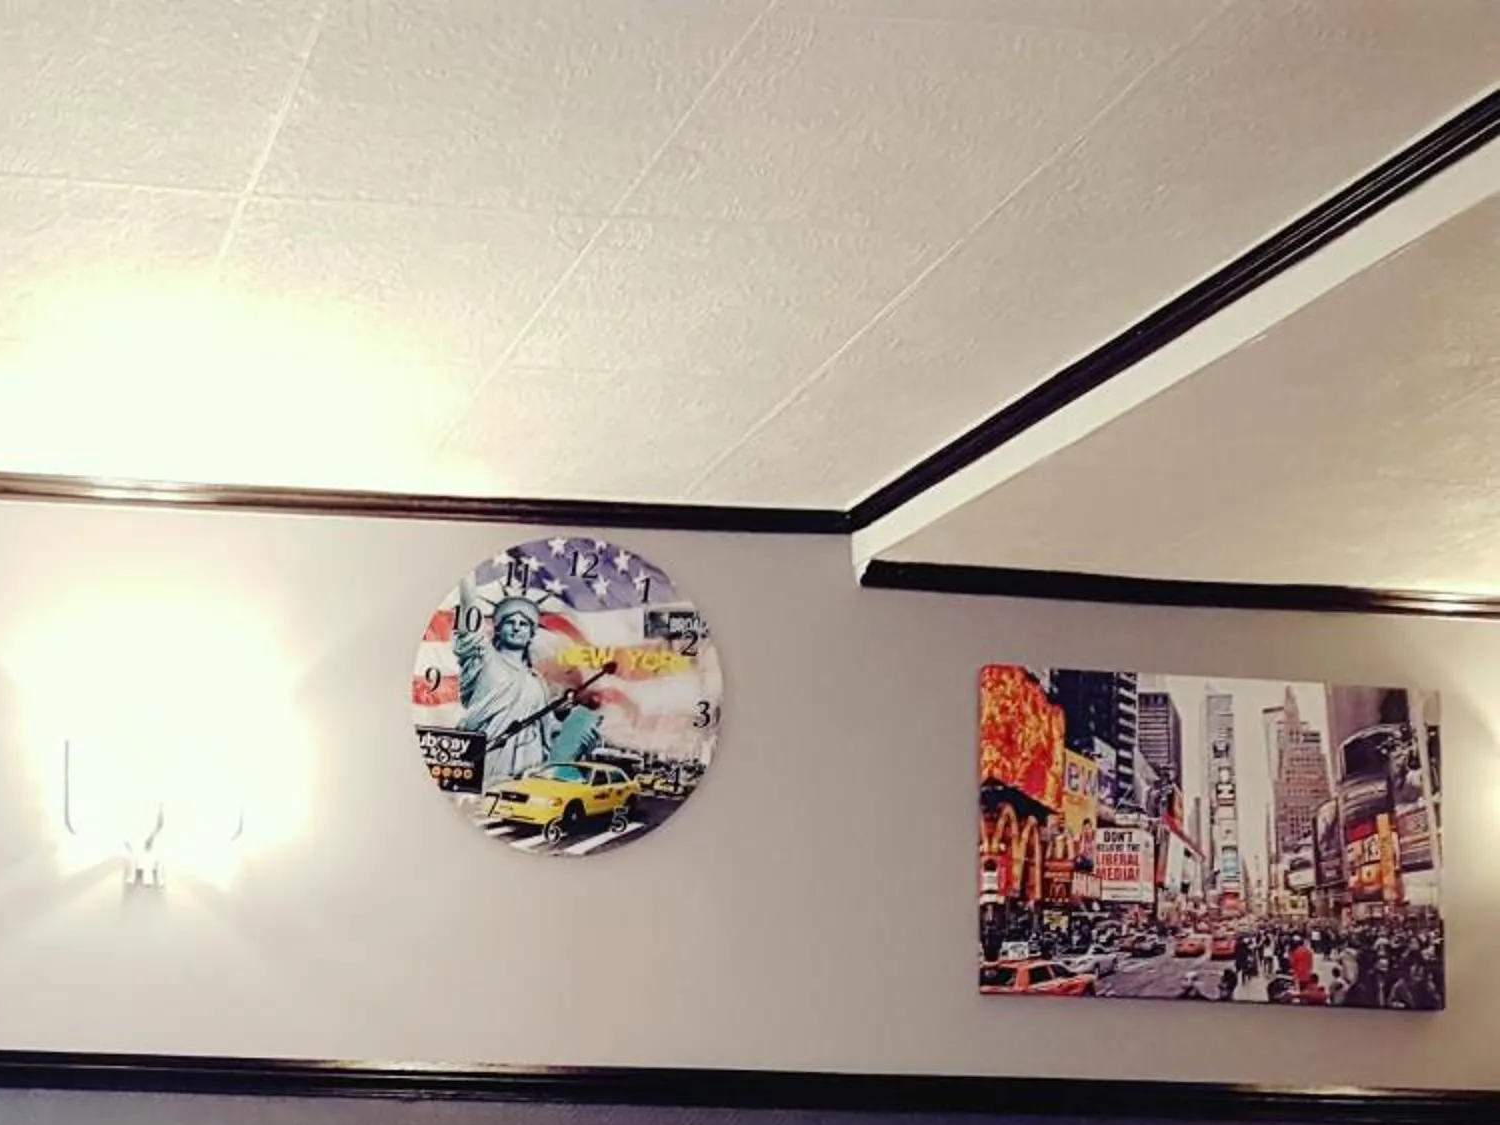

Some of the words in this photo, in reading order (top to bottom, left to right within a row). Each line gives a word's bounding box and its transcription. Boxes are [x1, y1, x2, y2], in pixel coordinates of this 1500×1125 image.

[505, 561, 530, 590] 11
[569, 550, 599, 580] 12
[639, 577, 651, 603] 1
[452, 605, 482, 632] 10
[680, 630, 699, 657] 2
[424, 667, 442, 692] 9
[693, 701, 712, 728] 3
[485, 791, 500, 817] 7
[611, 806, 629, 832] 5
